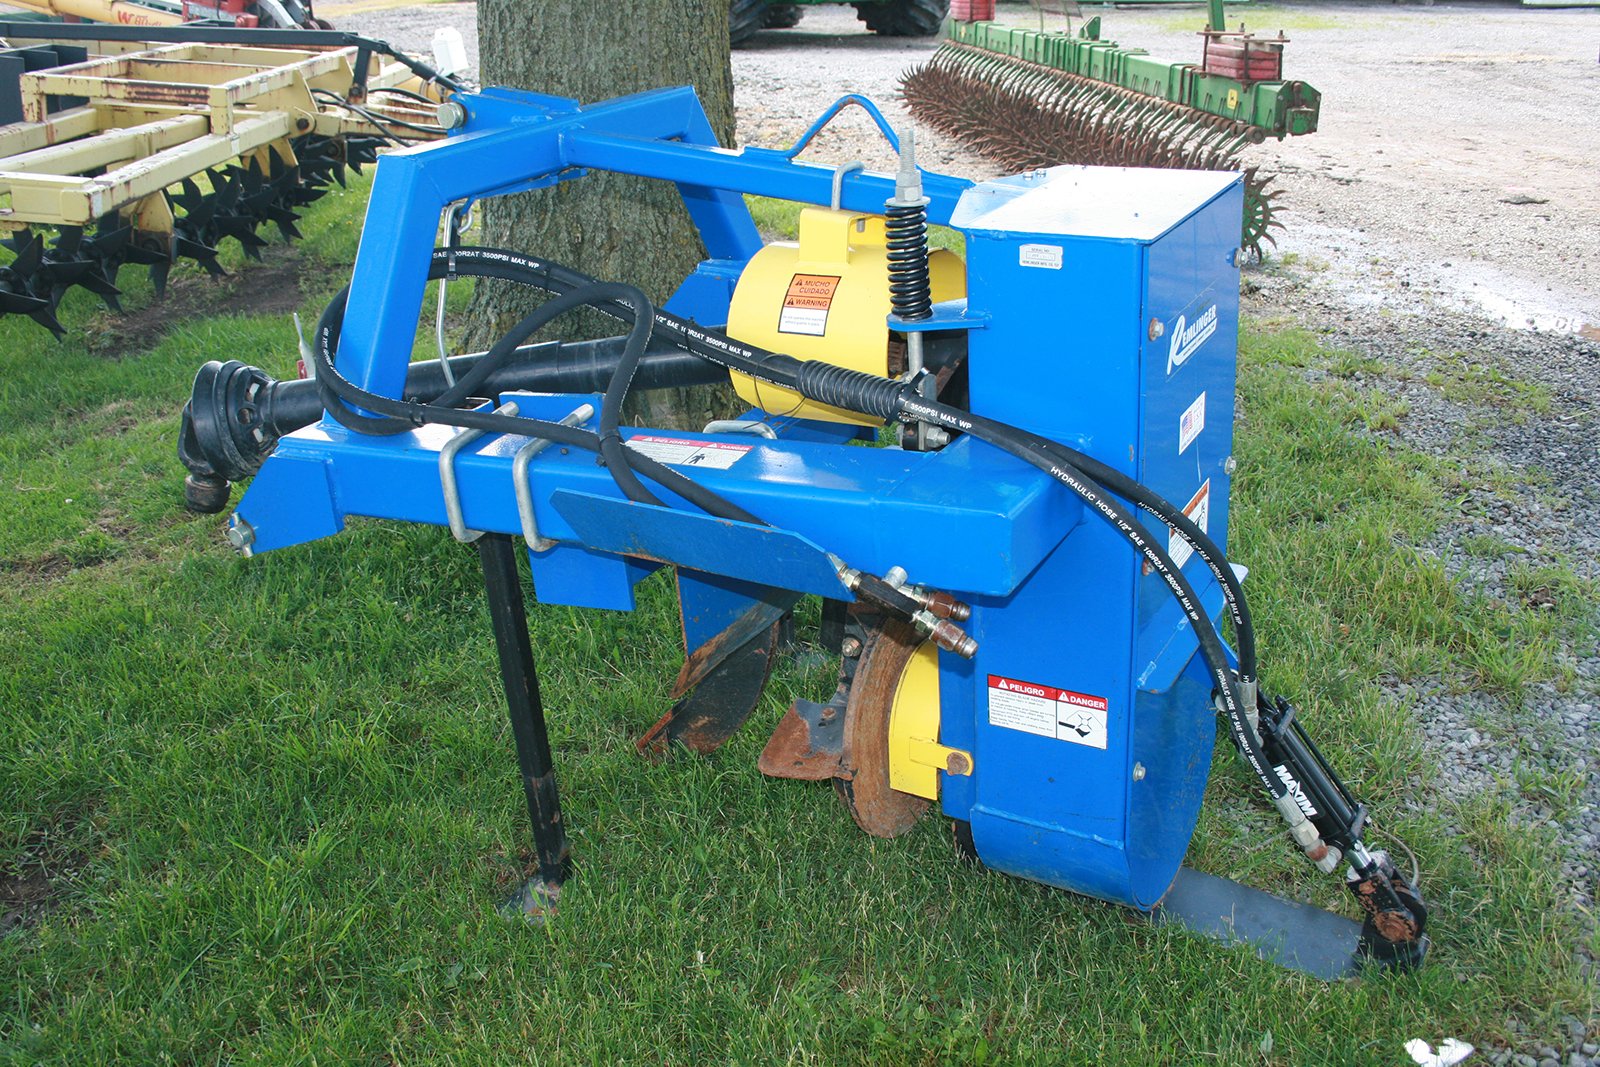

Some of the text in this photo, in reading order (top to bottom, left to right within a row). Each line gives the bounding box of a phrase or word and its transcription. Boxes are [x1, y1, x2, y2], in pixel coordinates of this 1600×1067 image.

[482, 252, 509, 262] 3500PSI
[511, 257, 526, 266] MAX
[528, 261, 540, 269] WP
[667, 320, 679, 330] SAE
[706, 336, 727, 350] 3500PSI
[729, 344, 741, 355] MAX
[742, 349, 752, 358] WP
[1167, 304, 1217, 375] REMLINGER
[910, 402, 938, 417] 3500PSI
[940, 413, 957, 424] MAX
[959, 420, 972, 429] WP
[1051, 466, 1096, 501] HYDRAULIC
[1096, 500, 1118, 520] HOSE
[1117, 520, 1132, 531] 1/2"
[1129, 532, 1144, 546] SAE
[1143, 547, 1168, 572] 100R2AT
[1165, 573, 1184, 596] 3500PSI
[1181, 597, 1194, 610] MAX
[1190, 611, 1199, 621] WP
[1138, 502, 1175, 528] HYDRAULIC
[1174, 526, 1191, 540] HOSE
[1230, 603, 1239, 614] MAX
[1235, 616, 1242, 624] WP
[1010, 683, 1105, 709] PELIGRO DANGER
[1216, 668, 1230, 696] HYDRAULIC
[1225, 696, 1236, 710] HOSE
[1234, 721, 1243, 734] SAE
[1248, 755, 1264, 775] 3500PSI
[1261, 776, 1272, 788] MAX
[1270, 789, 1280, 799] WP
[1273, 764, 1318, 816] MAXIM
